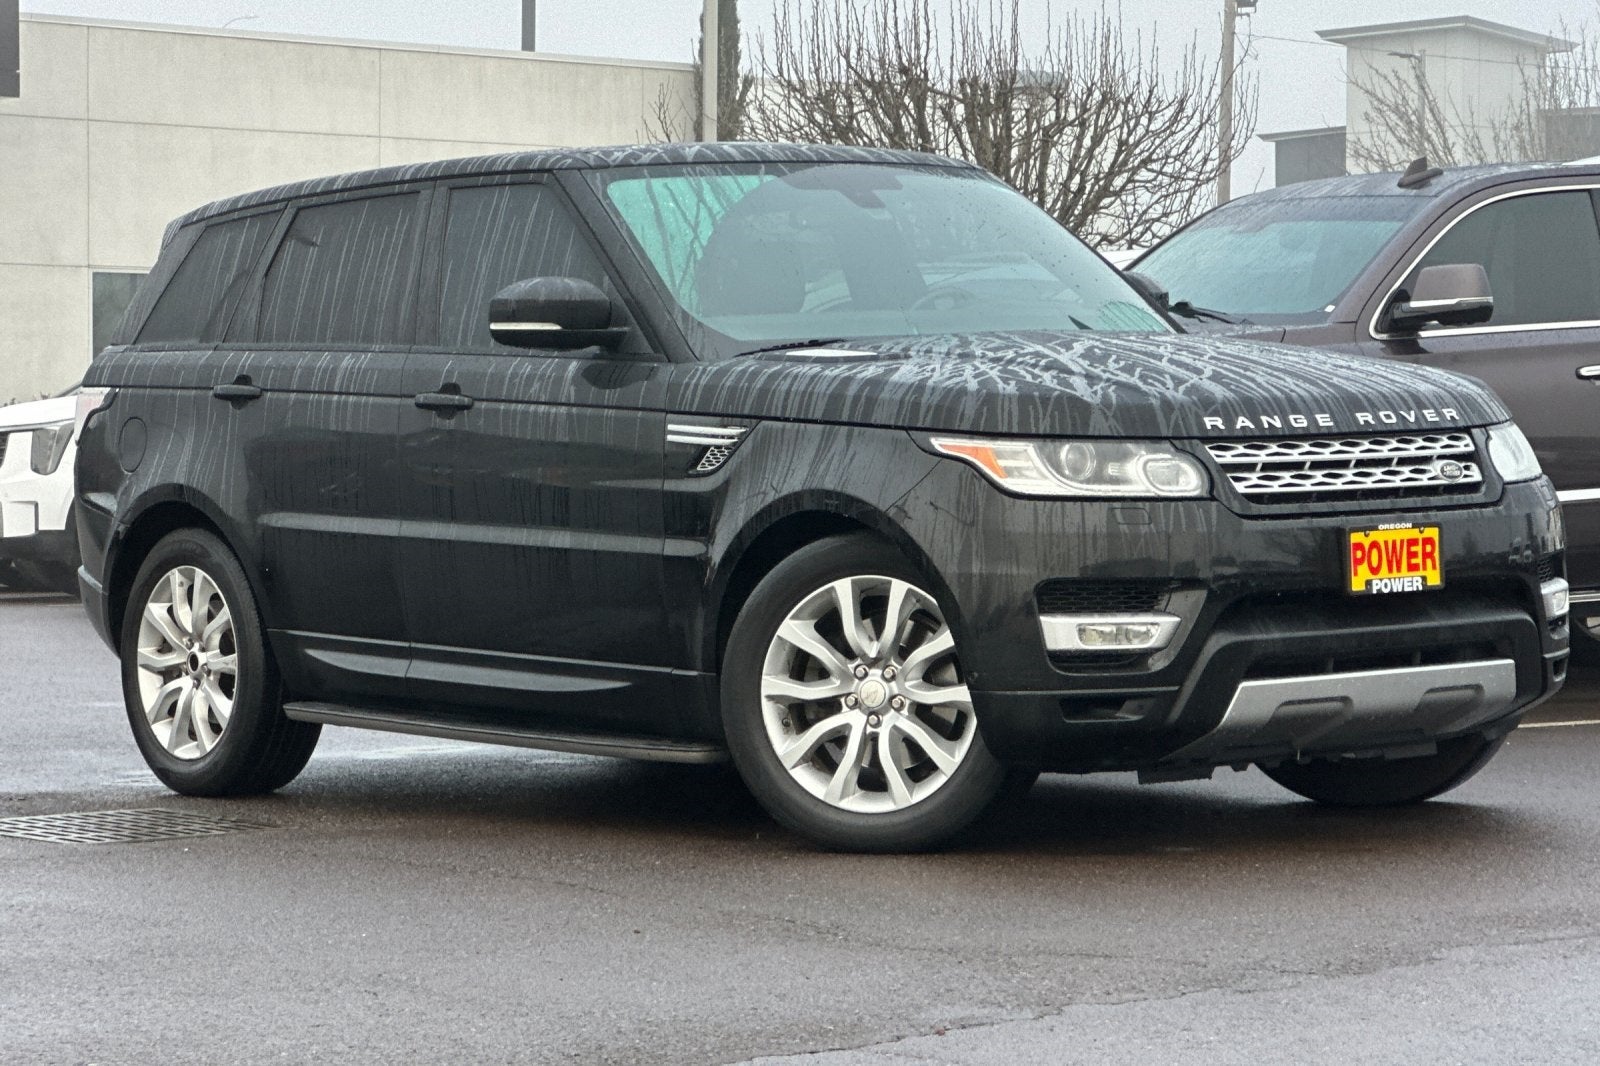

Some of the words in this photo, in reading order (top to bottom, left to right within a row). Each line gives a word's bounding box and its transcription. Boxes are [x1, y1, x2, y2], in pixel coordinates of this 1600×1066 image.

[1203, 413, 1334, 430] RANGE
[1355, 408, 1460, 425] ROVER
[1378, 522, 1412, 530] OREGON
[1351, 537, 1437, 577] POWER
[1372, 576, 1423, 594] POWER
